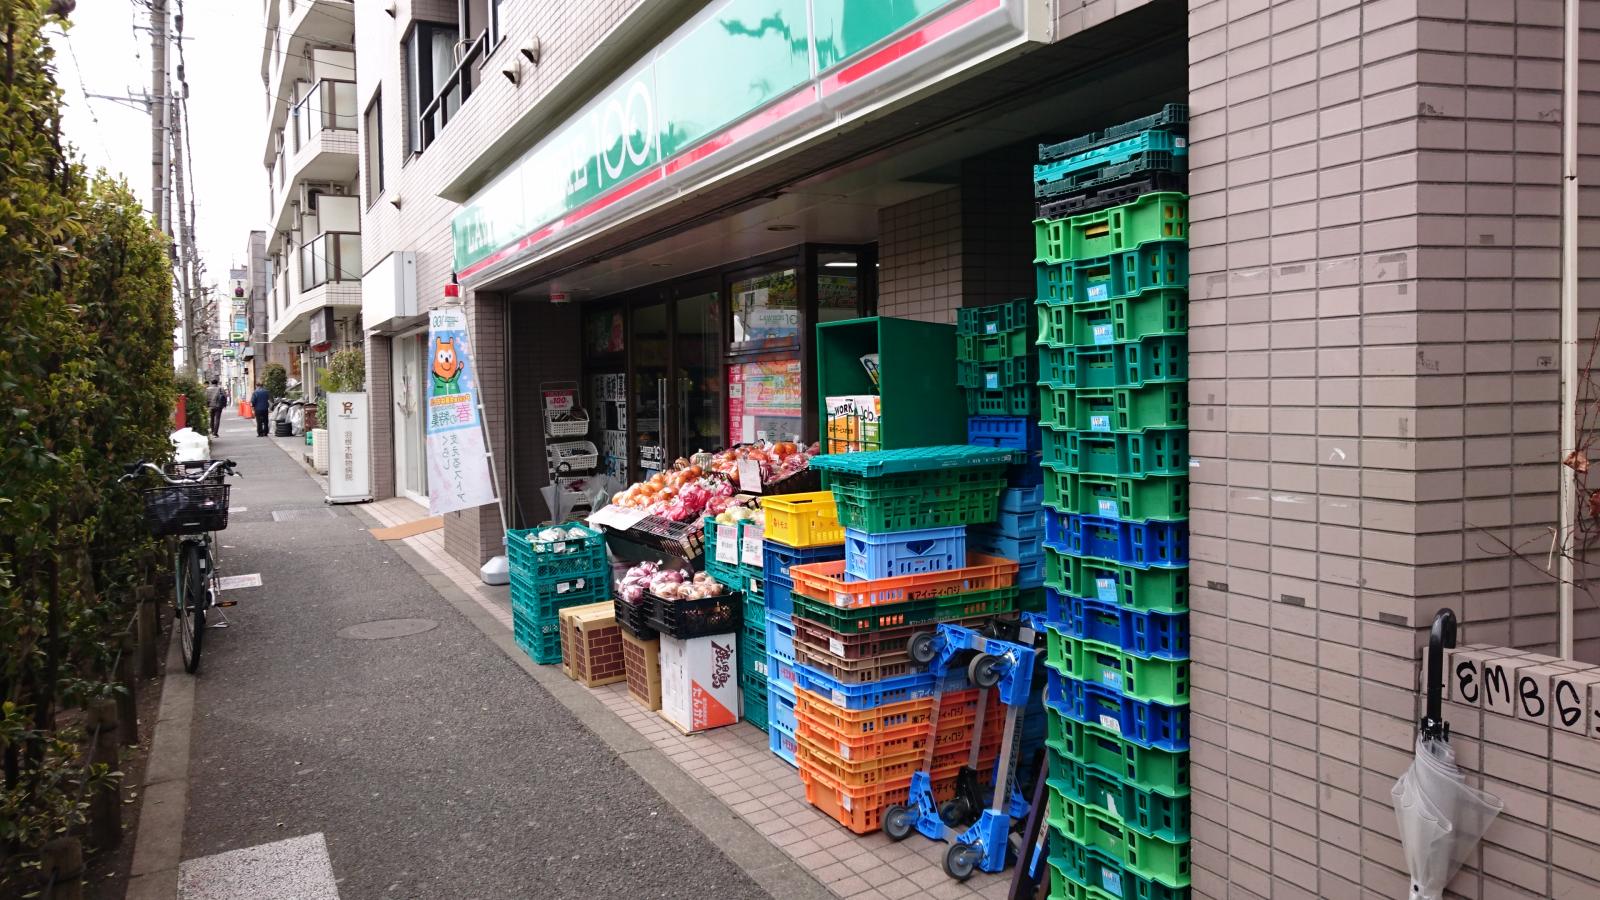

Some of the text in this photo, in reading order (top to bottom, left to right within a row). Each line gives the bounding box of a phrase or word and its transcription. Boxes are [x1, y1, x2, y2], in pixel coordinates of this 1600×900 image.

[591, 81, 653, 188] 100
[231, 333, 244, 342] P
[834, 403, 853, 416] WORK
